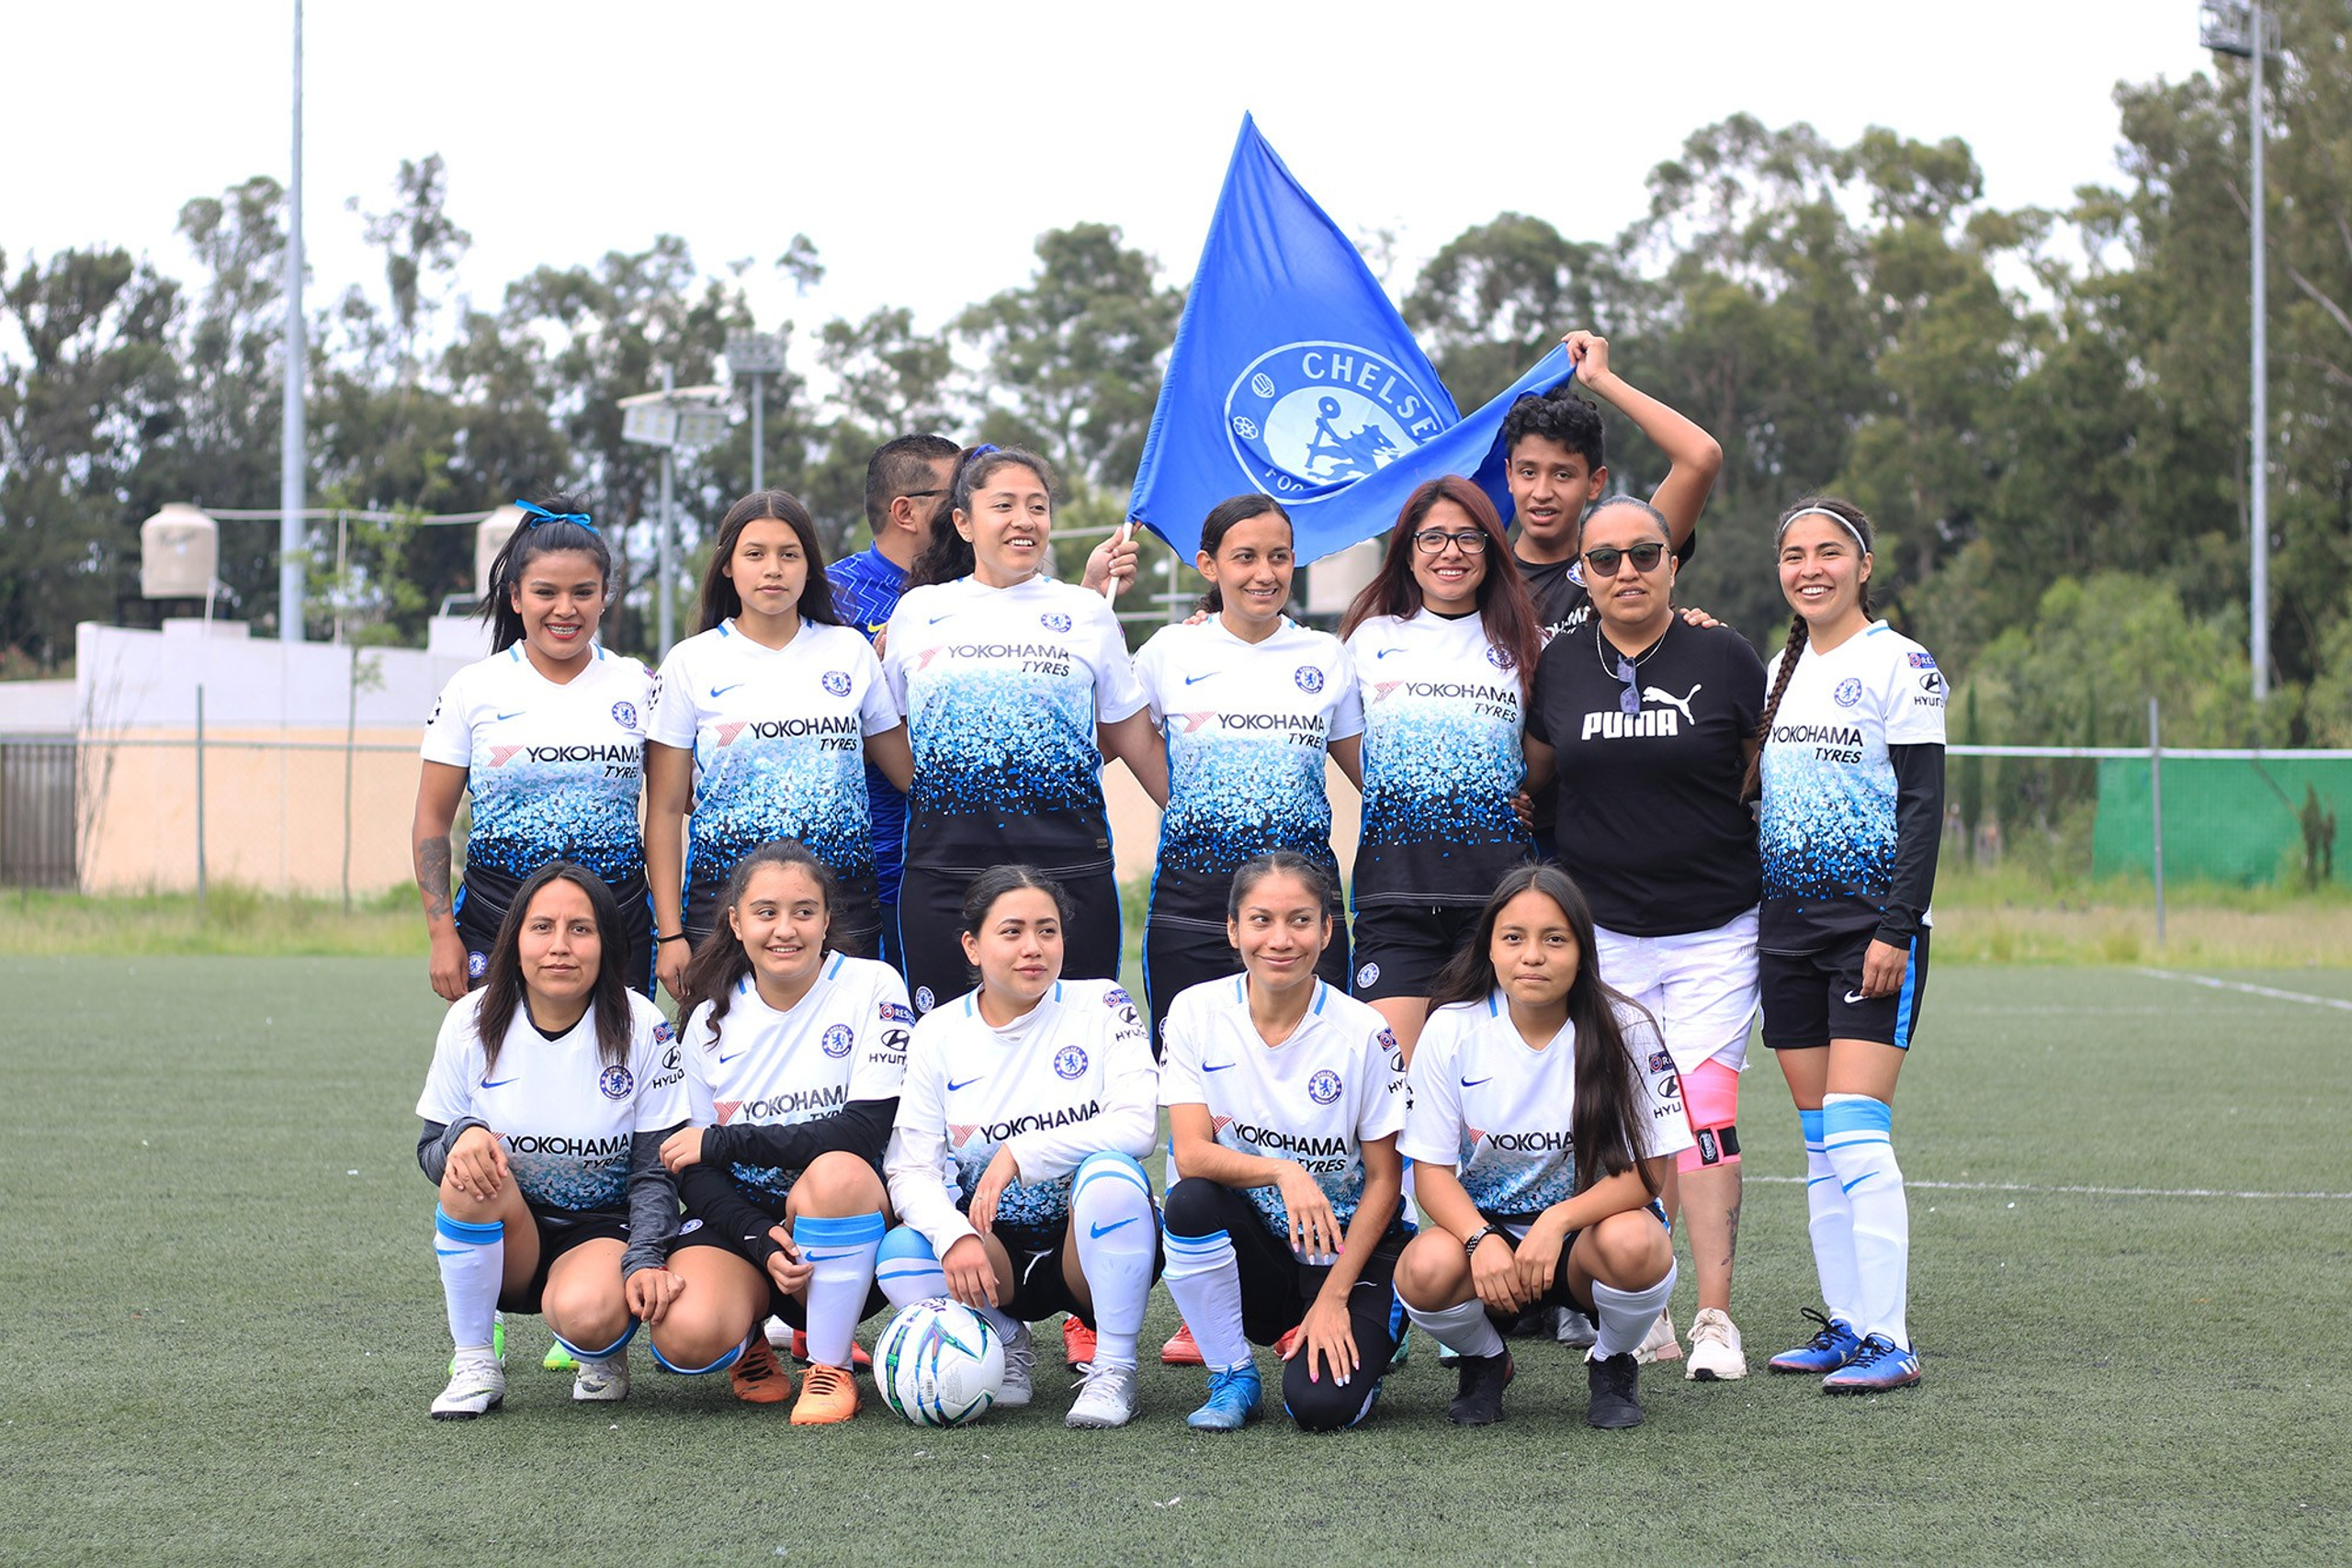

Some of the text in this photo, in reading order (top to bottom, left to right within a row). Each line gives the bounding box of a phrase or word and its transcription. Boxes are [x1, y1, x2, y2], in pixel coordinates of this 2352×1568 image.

[1302, 352, 1438, 443] CHELSE
[947, 644, 1070, 661] YOKOHAMA
[1022, 660, 1070, 677] TYRES
[1406, 682, 1518, 709] YOKOHAMA
[1217, 714, 1325, 733] YOKOHAMA
[1474, 703, 1517, 724] TYRES
[750, 716, 858, 739] YOKOHAMA
[1581, 708, 1679, 741] PUMA
[820, 738, 858, 751] TYRES
[1771, 725, 1864, 747] YOKOHAMA
[526, 744, 640, 763] YOKOHAMA
[1815, 747, 1862, 764] TYRES
[980, 1100, 1101, 1145] YOKOHAMA
[506, 1133, 629, 1156] YOKOHAMA
[1232, 1122, 1348, 1156] YOKOHAMA
[1487, 1131, 1573, 1152] YOKOHA
